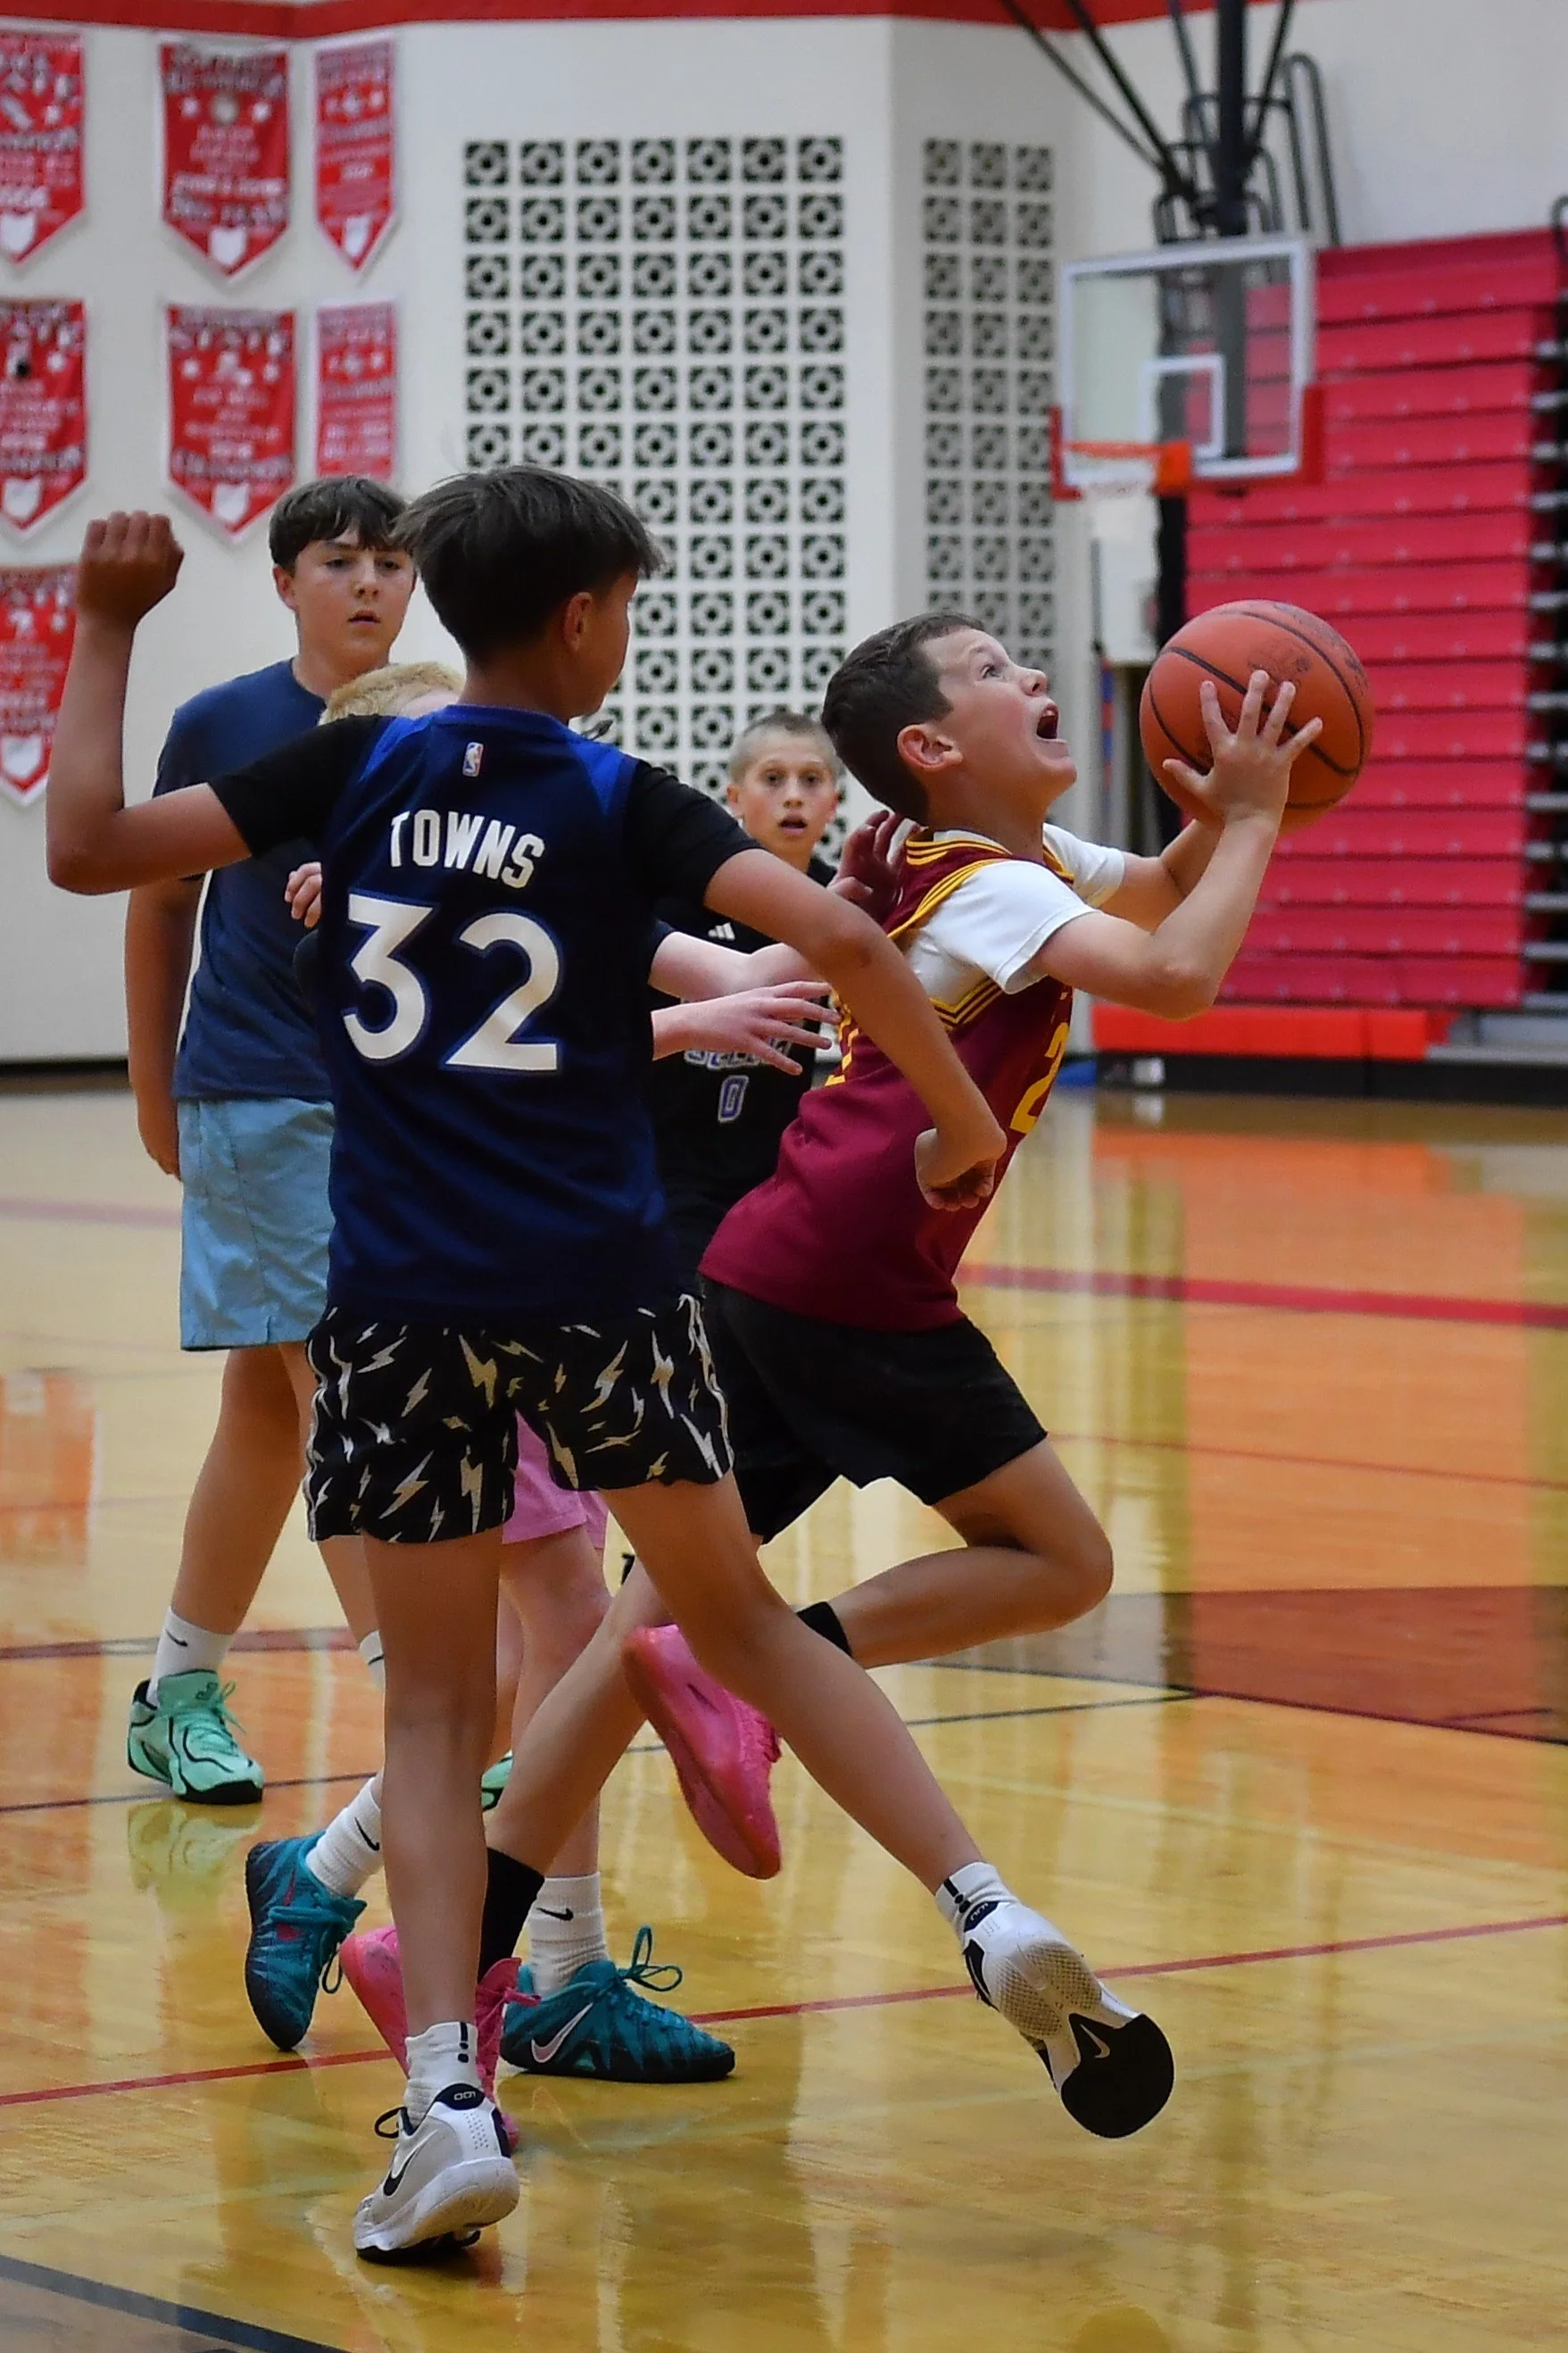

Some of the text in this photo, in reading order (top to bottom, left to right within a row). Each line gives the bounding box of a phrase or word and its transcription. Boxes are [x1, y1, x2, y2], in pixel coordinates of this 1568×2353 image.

[391, 809, 544, 889] TOWNS
[343, 894, 560, 1071] 32
[718, 1075, 750, 1124] 0
